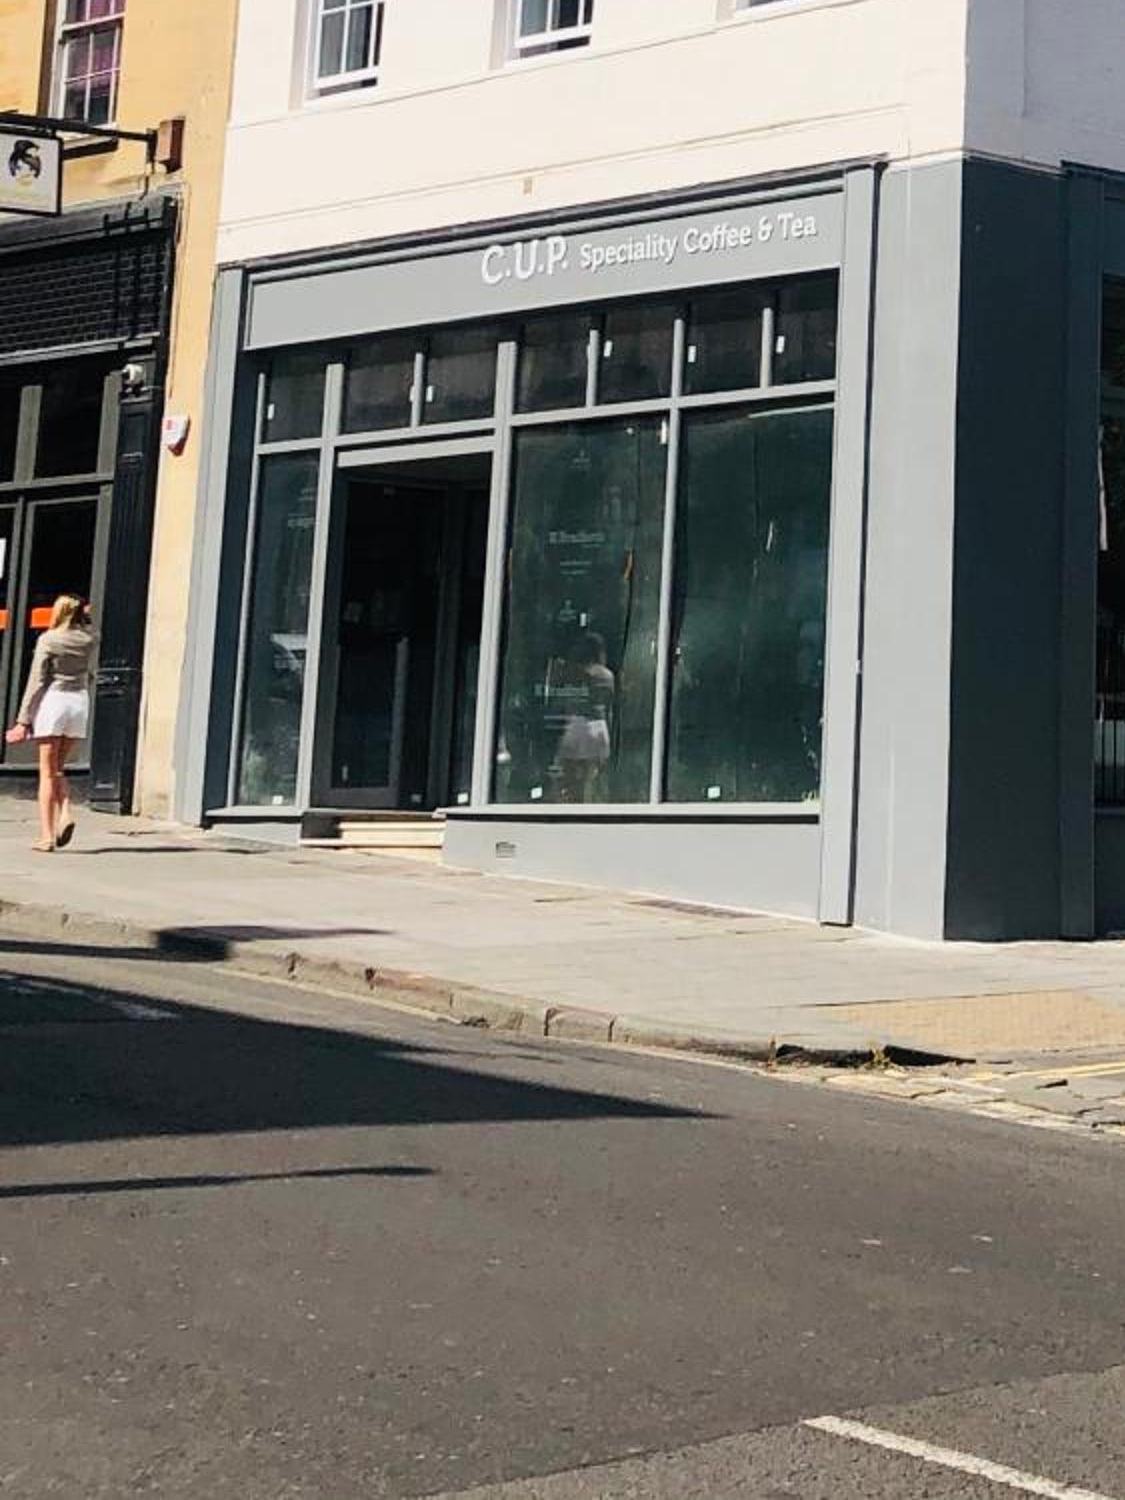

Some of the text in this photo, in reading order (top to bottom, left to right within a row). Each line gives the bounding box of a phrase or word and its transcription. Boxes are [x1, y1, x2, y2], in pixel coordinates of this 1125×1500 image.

[580, 234, 678, 273] Speciality
[683, 225, 752, 252] Coffee
[757, 215, 773, 241] &
[777, 213, 817, 239] Tea
